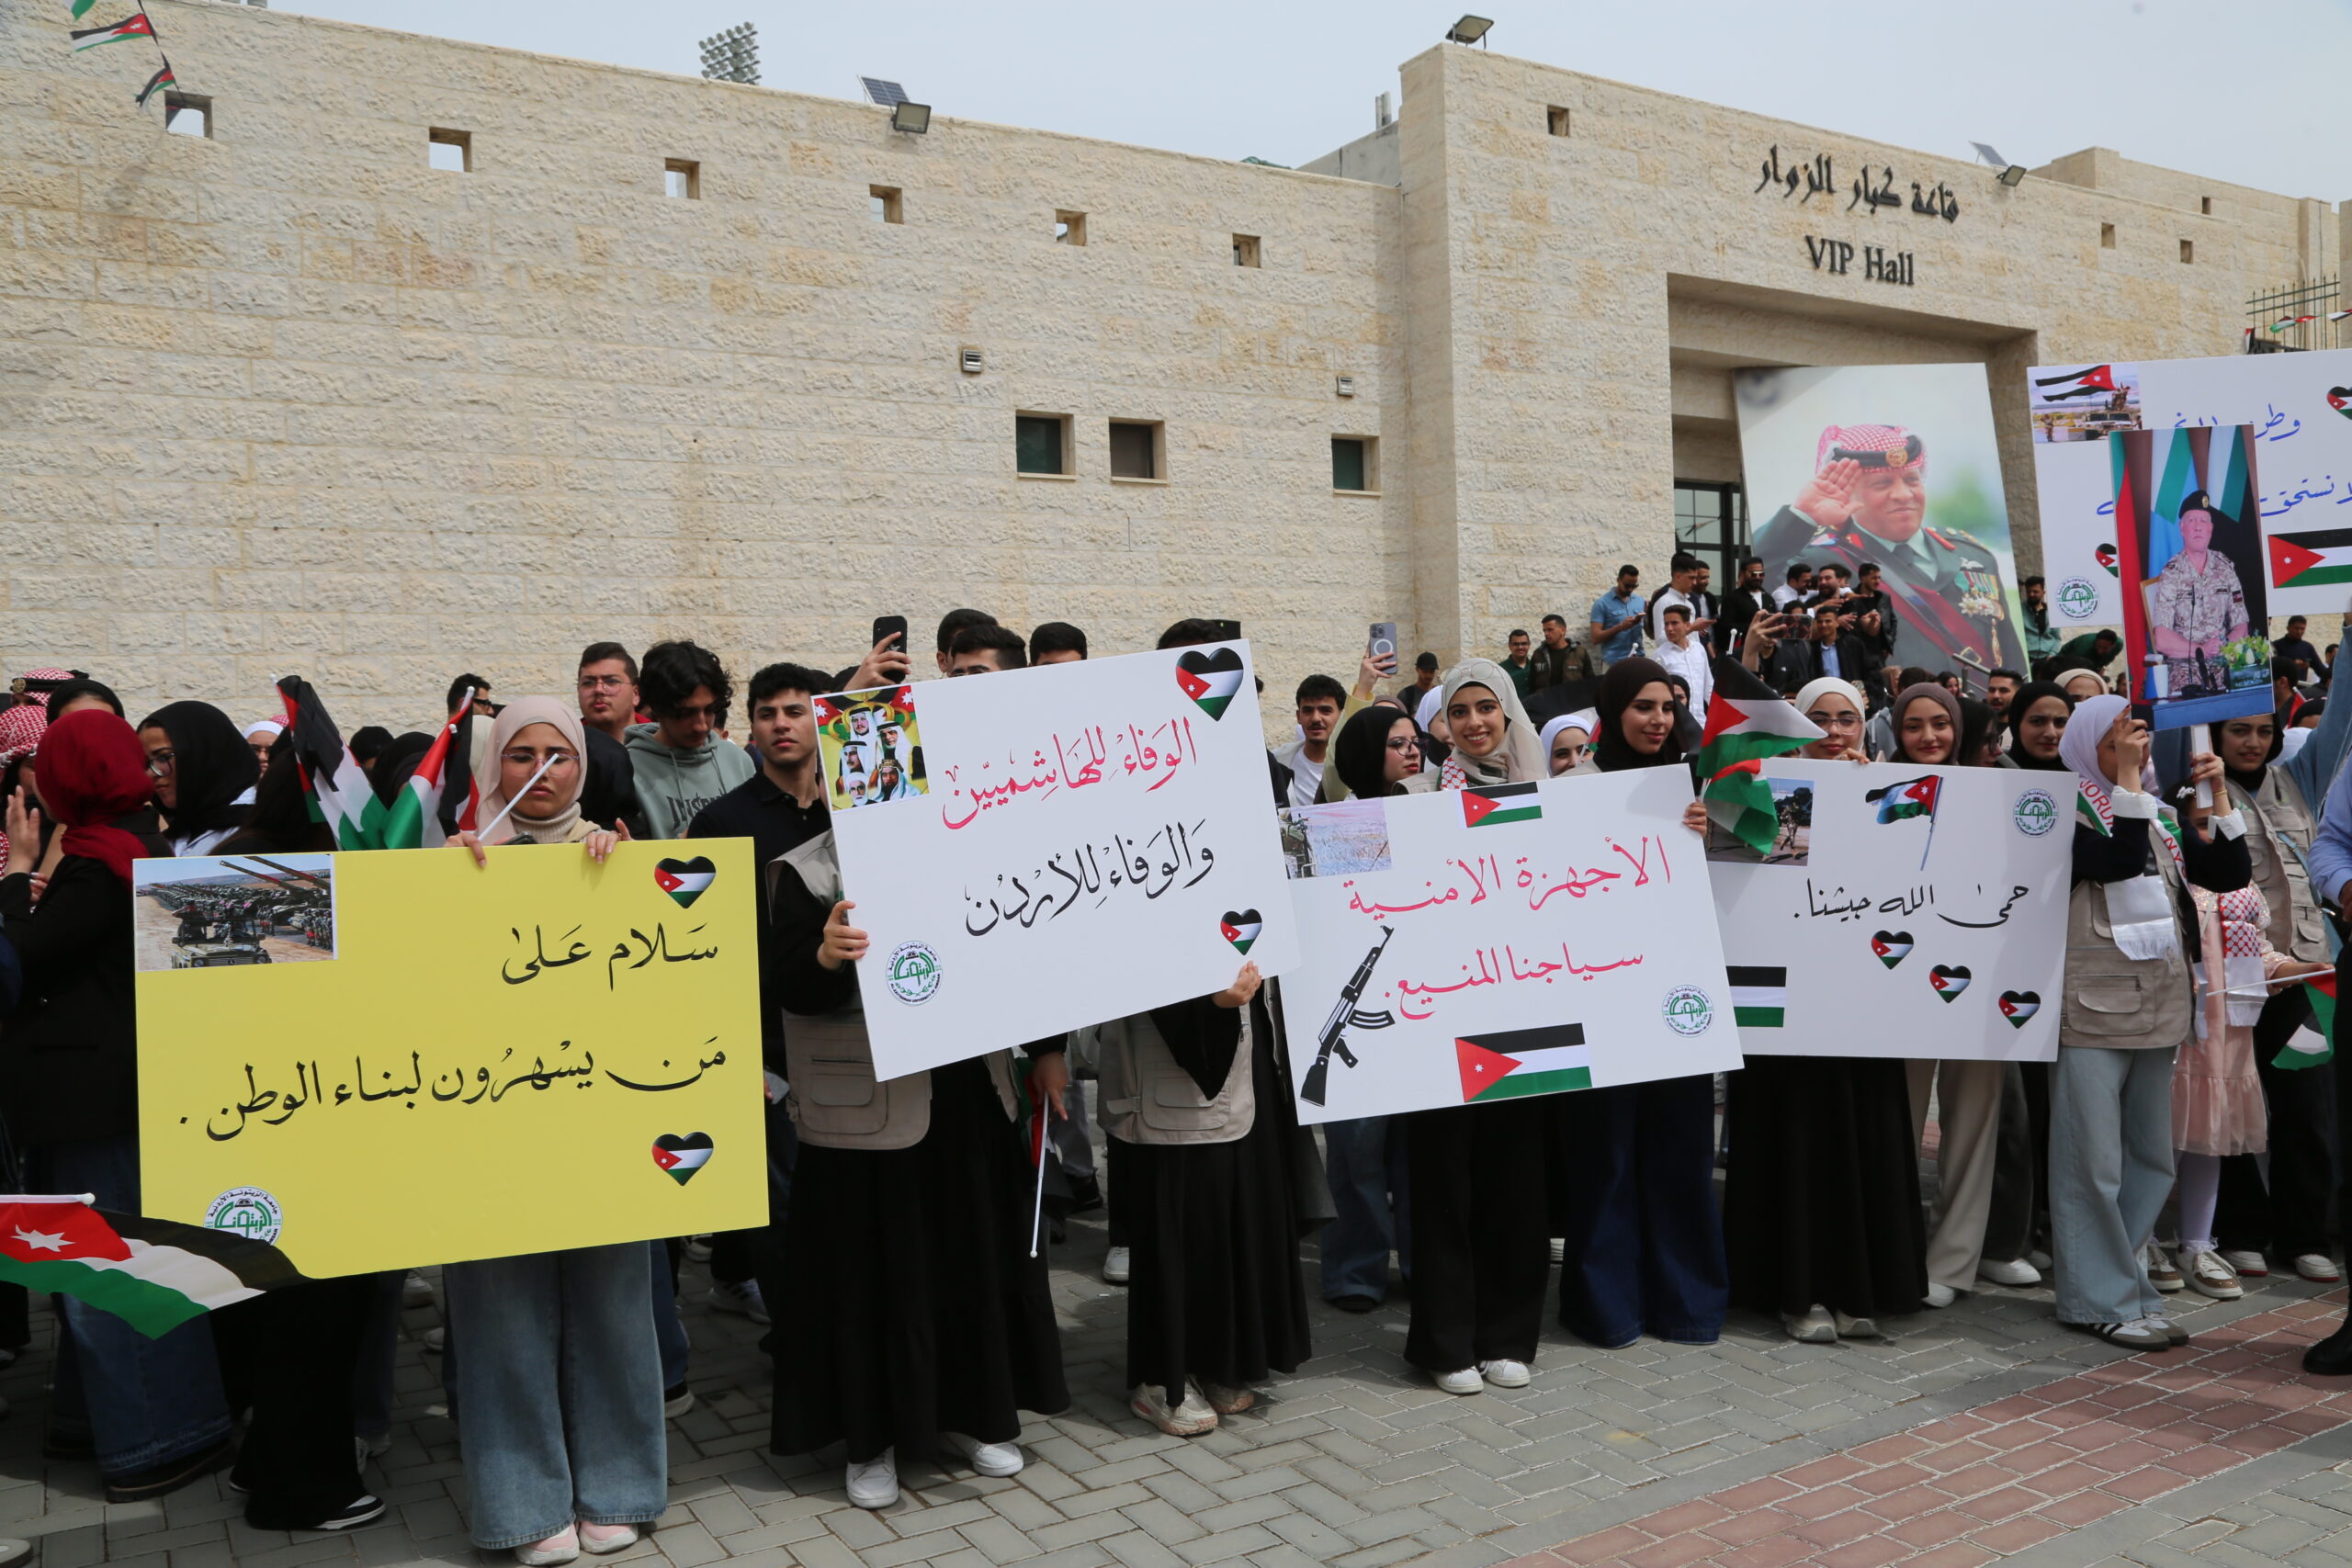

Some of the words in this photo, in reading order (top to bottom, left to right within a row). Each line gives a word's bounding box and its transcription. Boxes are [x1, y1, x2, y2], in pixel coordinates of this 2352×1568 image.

[1754, 143, 1836, 203] الزوار
[1847, 164, 1903, 214] كبار
[1911, 182, 1960, 223] قاعة
[1805, 234, 1854, 275] VIP
[1864, 245, 1915, 286] Hall
[1879, 885, 1934, 916] الله
[1505, 942, 1644, 983] سياجنا
[334, 1050, 422, 1110] لبناء
